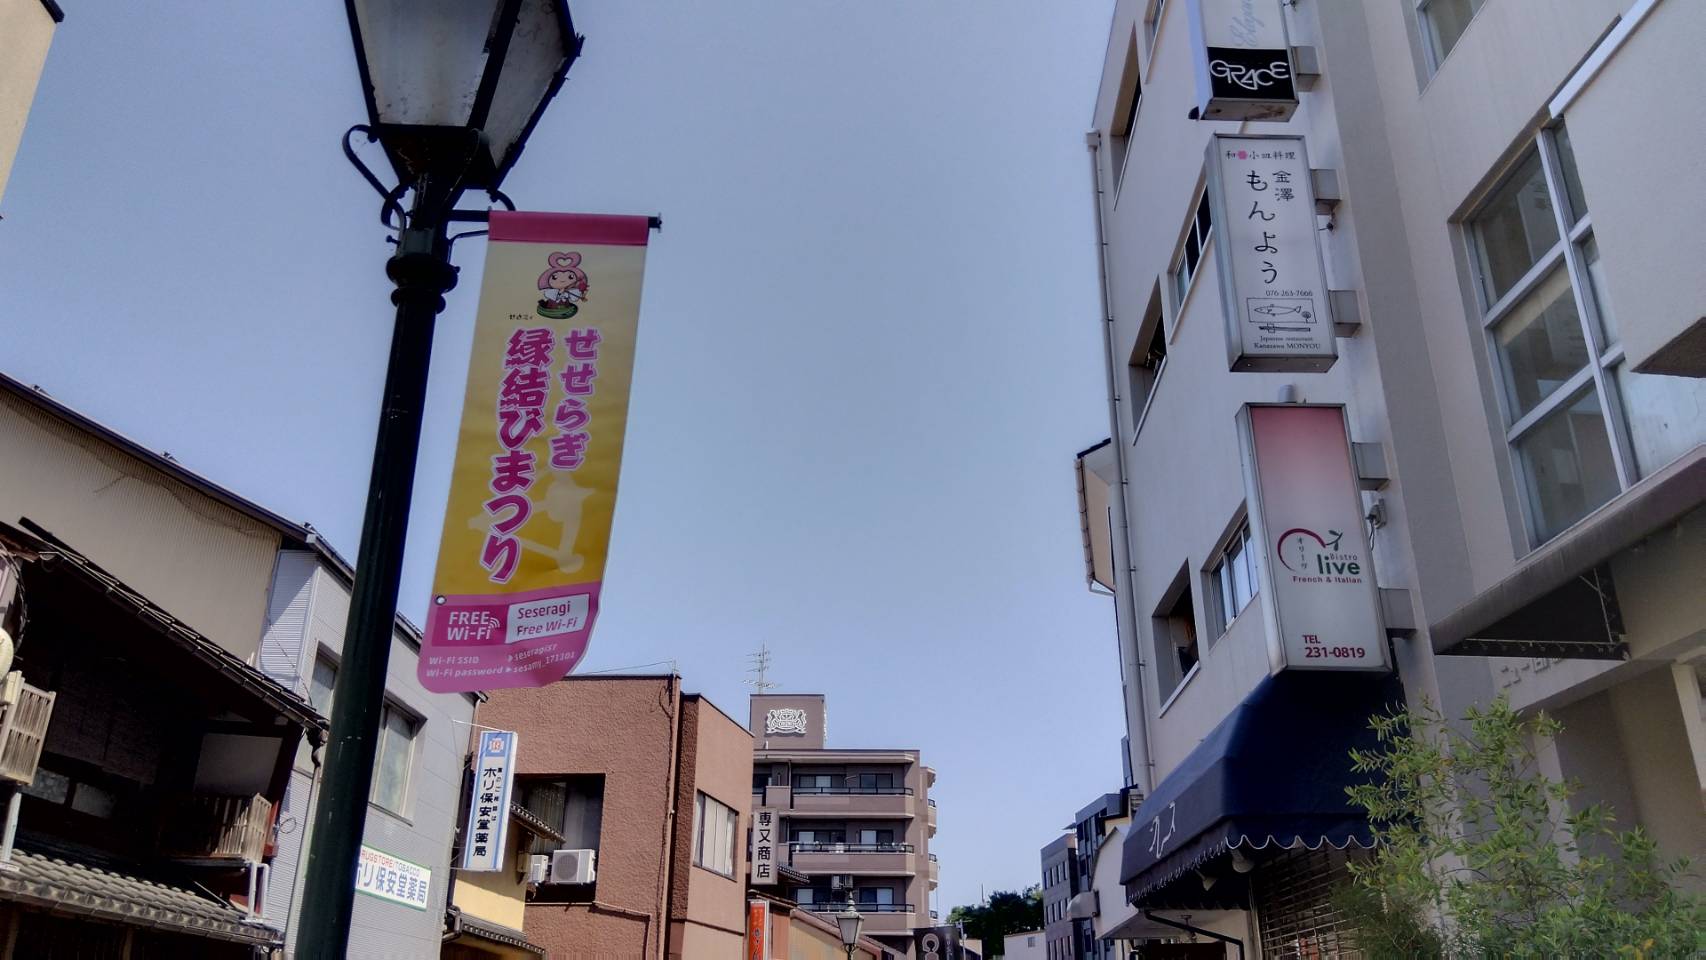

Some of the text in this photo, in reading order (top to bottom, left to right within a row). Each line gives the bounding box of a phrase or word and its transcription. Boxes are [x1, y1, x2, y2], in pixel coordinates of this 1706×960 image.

[1210, 60, 1289, 90] GRACE
[1272, 170, 1295, 201] 金澤
[1246, 170, 1278, 284] もんよう
[551, 327, 600, 470] せせらぎ
[481, 327, 554, 583] 縁結びまつり
[449, 611, 490, 625] FREE
[517, 601, 571, 619] Seseragi
[447, 626, 491, 640] Wi-Fi
[516, 616, 578, 636] Free Wi-Fi
[428, 656, 456, 665] Wi-Fi
[457, 656, 480, 665] SSID
[1305, 647, 1366, 658] 231-0819
[426, 669, 453, 678] Wi-Fi
[454, 667, 503, 678] password
[473, 767, 497, 857] ホリ保安堂薬局
[757, 812, 772, 878] 専又商店
